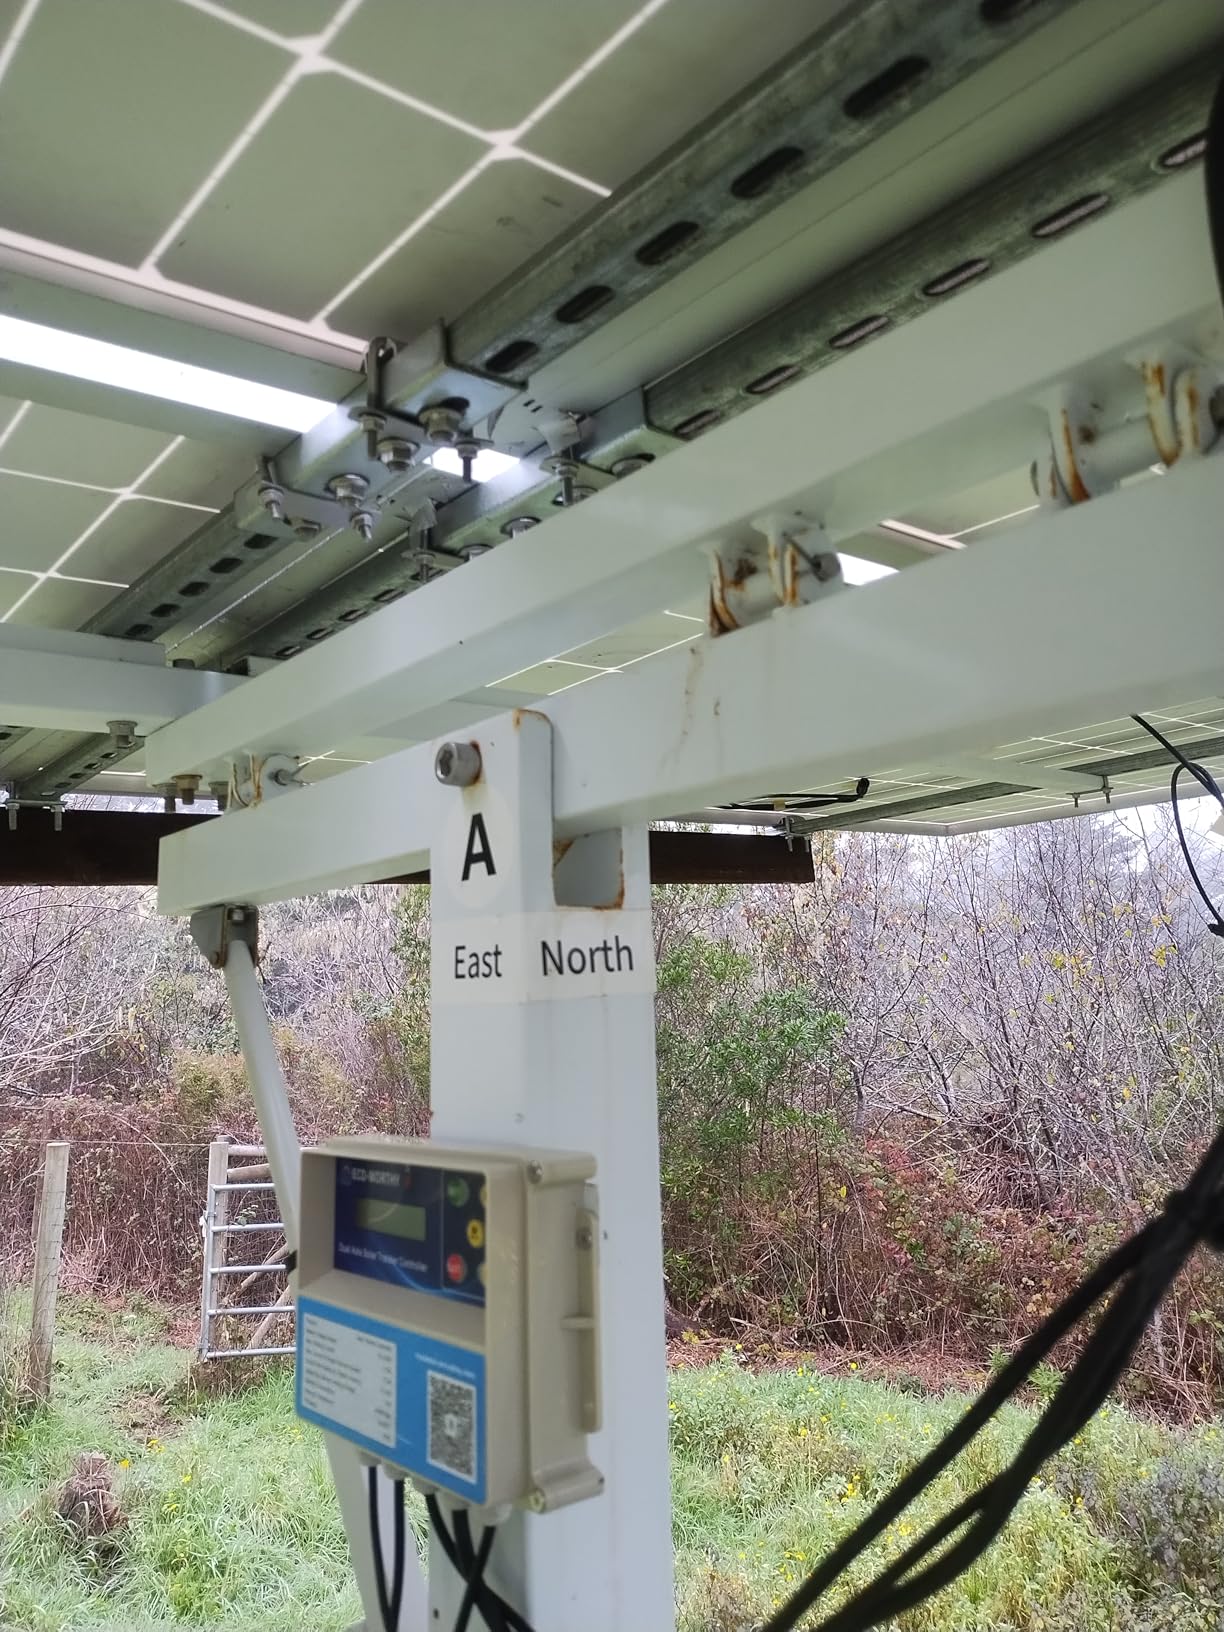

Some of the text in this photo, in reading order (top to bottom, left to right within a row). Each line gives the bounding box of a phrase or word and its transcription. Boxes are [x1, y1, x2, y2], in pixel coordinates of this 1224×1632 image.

[461, 811, 497, 882] A
[454, 943, 503, 979] East
[540, 935, 634, 977] North
